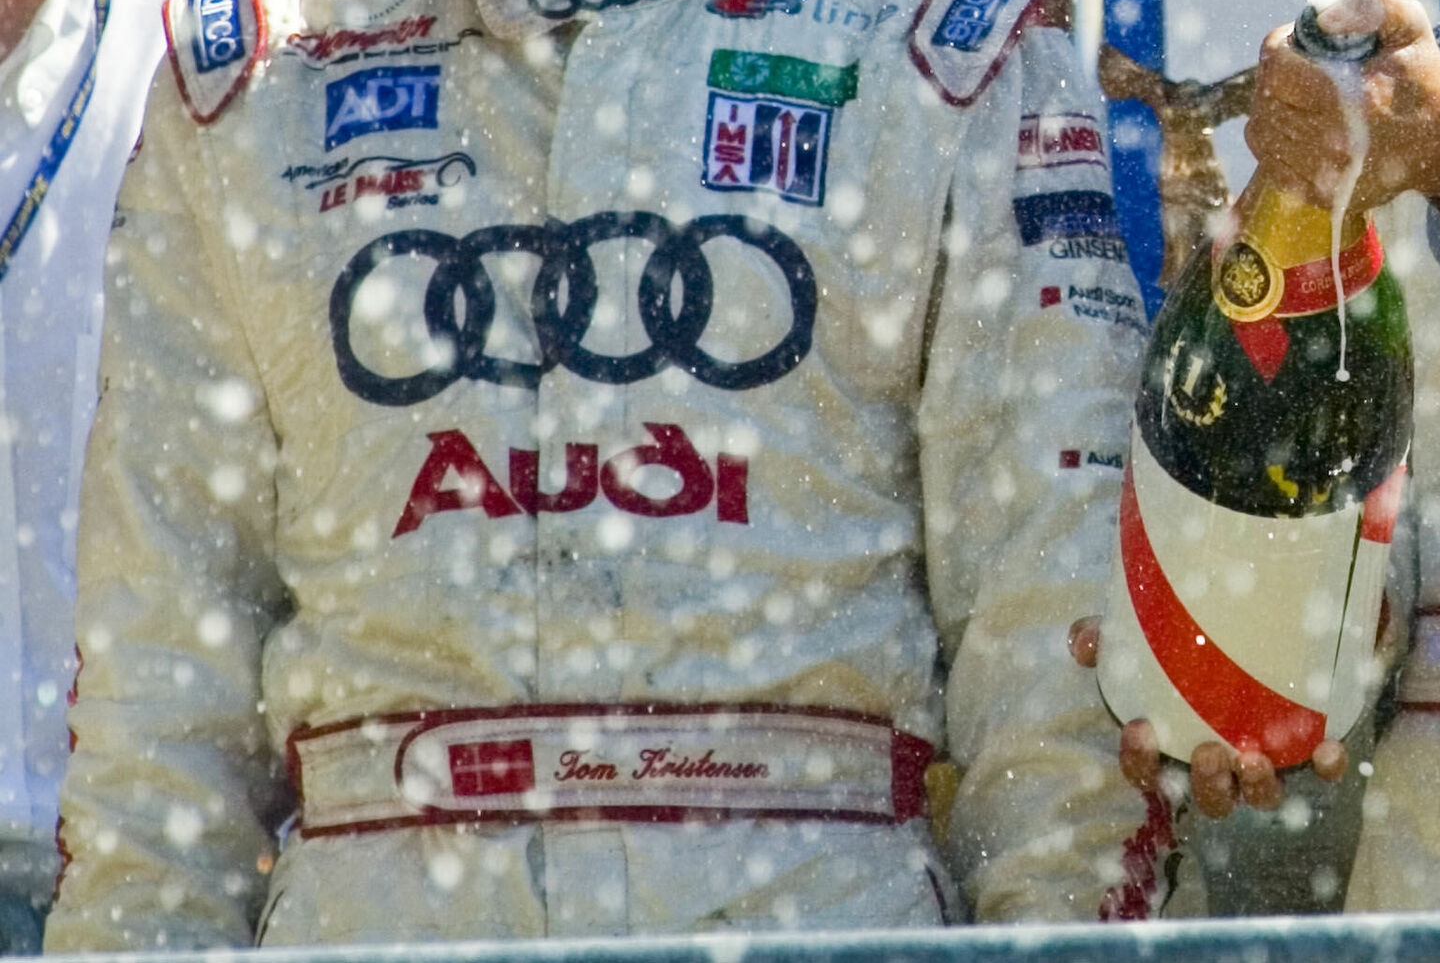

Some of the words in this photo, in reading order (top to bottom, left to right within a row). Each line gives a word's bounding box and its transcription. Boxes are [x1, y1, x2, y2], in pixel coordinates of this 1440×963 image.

[326, 76, 441, 136] ADT
[712, 104, 747, 183] IMSA
[319, 183, 348, 213] LE
[392, 422, 750, 538] Audi
[553, 749, 619, 782] Tom
[632, 747, 771, 781] Kristensen
